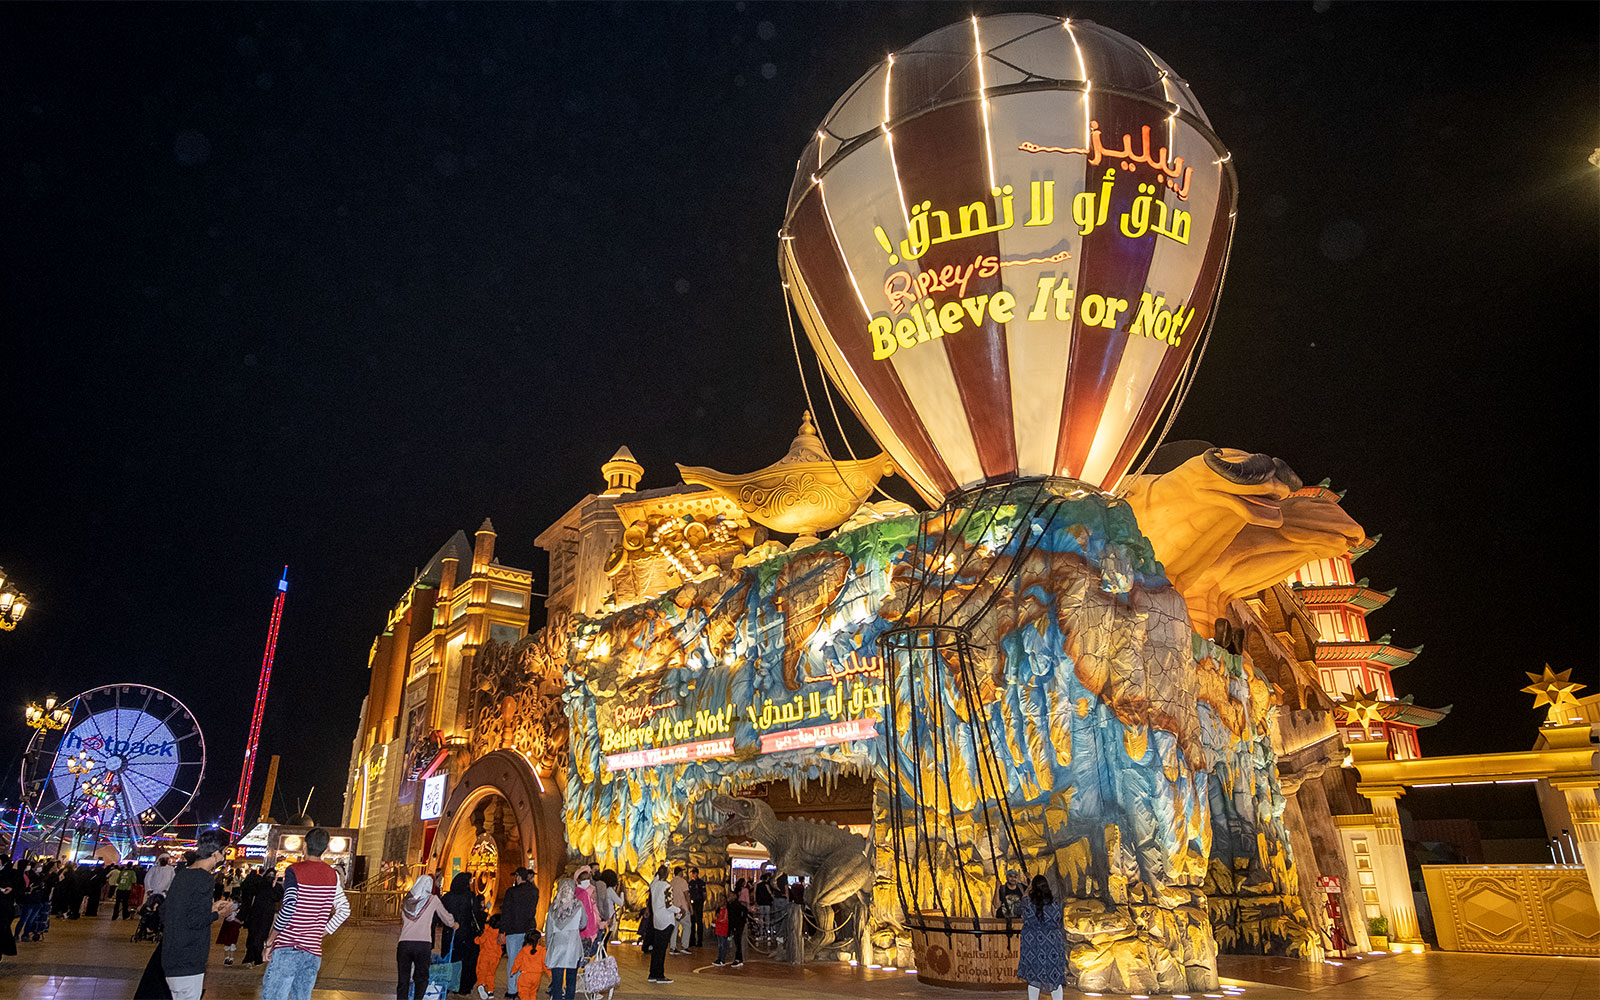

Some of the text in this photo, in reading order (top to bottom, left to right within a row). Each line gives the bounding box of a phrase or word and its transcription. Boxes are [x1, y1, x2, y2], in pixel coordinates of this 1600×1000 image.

[1024, 180, 1055, 227] لا
[1072, 167, 1116, 236] أو
[1119, 183, 1192, 245] صدق
[867, 276, 1195, 360] Believe It or Not!
[808, 691, 821, 718] لا
[826, 680, 843, 720] أو
[601, 703, 733, 751] Believe It or Not!
[647, 746, 688, 763] VILLAGE
[696, 740, 731, 757] DUBAI
[957, 964, 992, 977] Global
